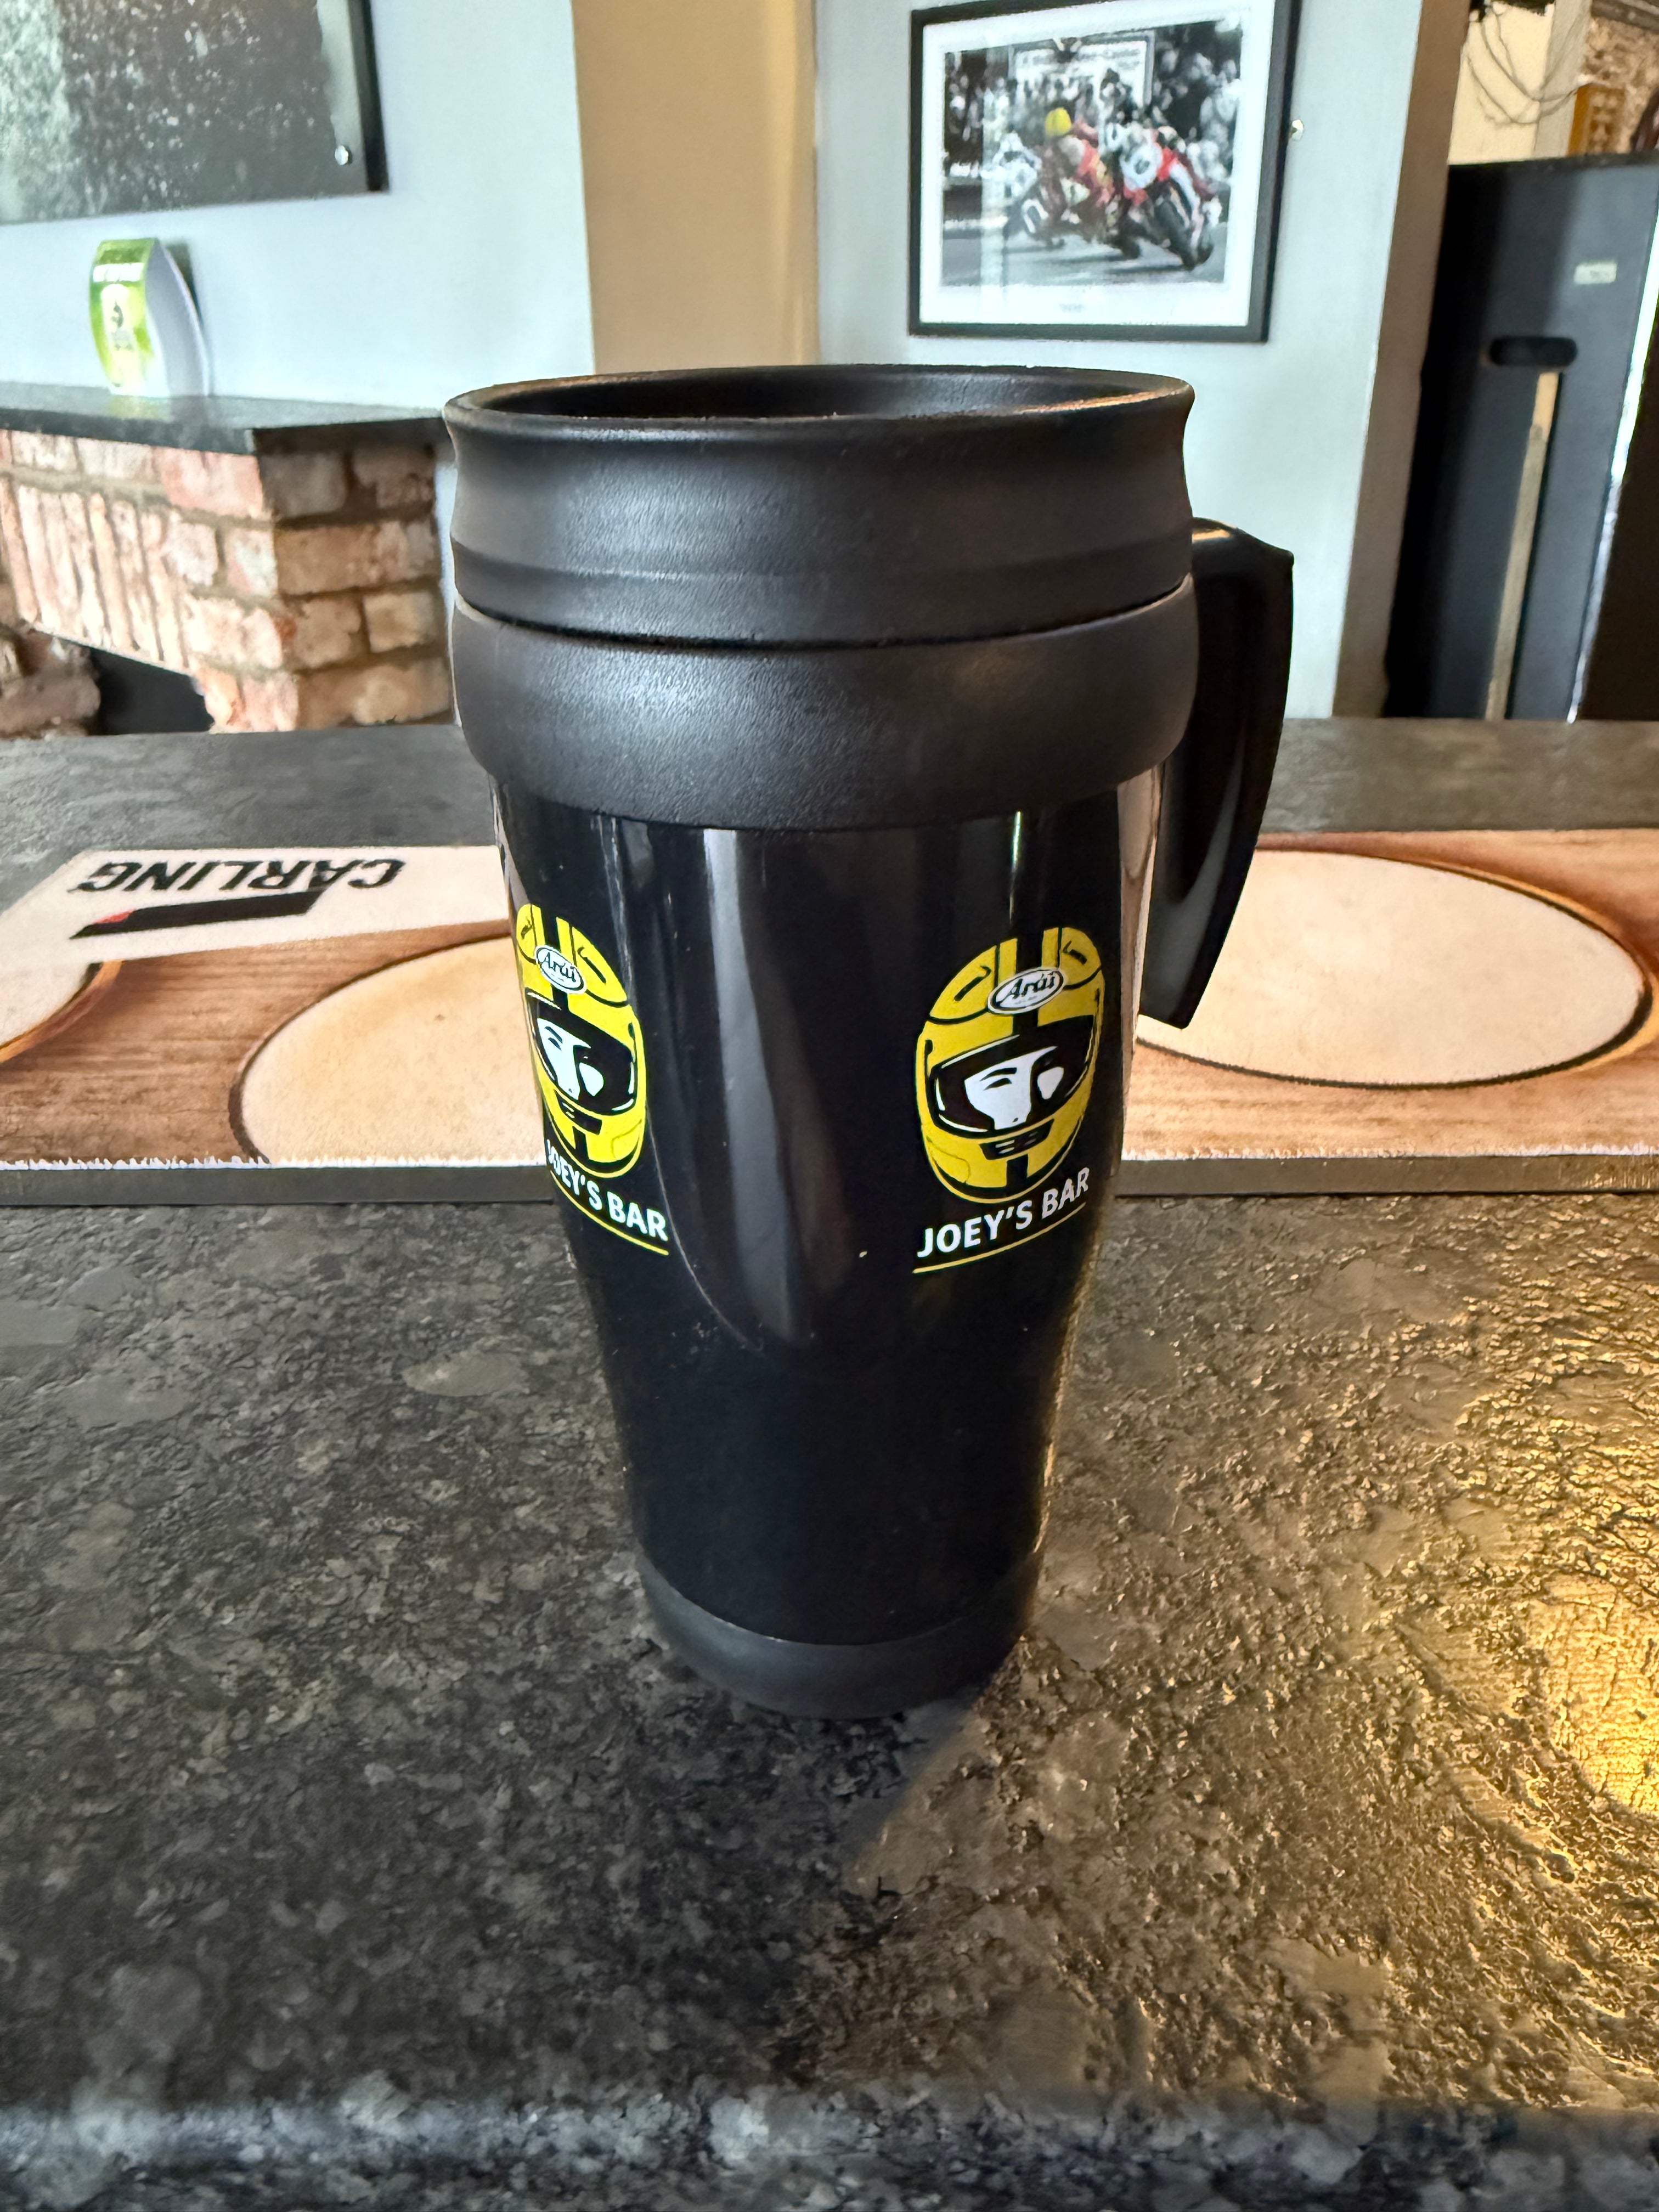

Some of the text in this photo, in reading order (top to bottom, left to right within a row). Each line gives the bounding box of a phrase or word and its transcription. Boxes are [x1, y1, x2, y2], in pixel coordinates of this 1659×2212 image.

[68, 859, 406, 893] CARLING
[1001, 970, 1056, 1004] Arai
[607, 1190, 668, 1242] BAR
[917, 1166, 1090, 1258] JOEY'S BAR
